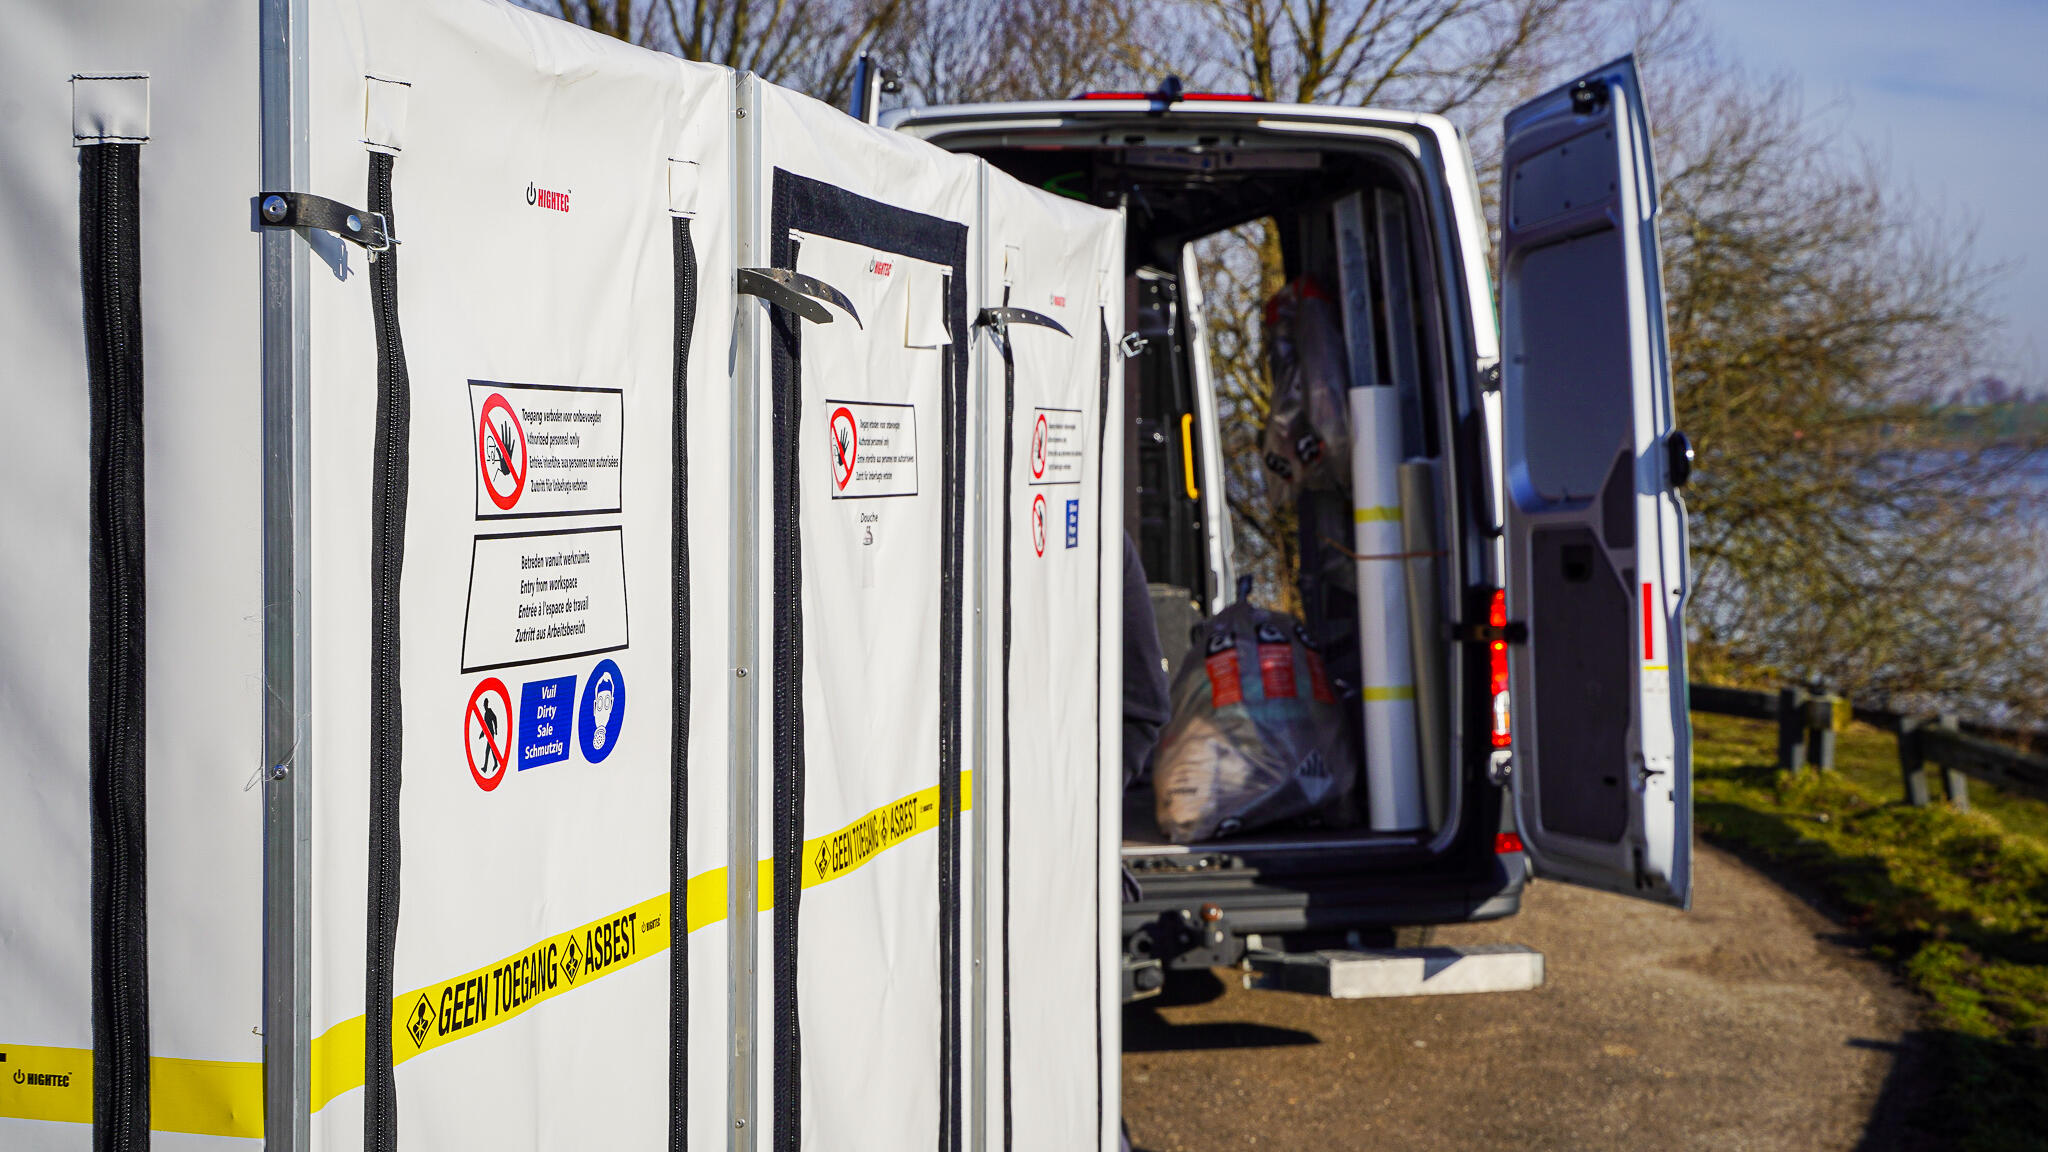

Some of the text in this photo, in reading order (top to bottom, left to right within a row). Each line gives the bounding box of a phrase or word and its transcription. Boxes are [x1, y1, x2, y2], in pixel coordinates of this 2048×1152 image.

[538, 188, 569, 212] HIGHTEC
[522, 408, 543, 425] Toegang
[570, 432, 580, 449] only
[521, 549, 590, 570] Betreden vanuit werkruimte
[520, 575, 577, 597] Entry from workspace
[518, 603, 537, 619] Entrée
[542, 601, 565, 619] l'espace
[566, 598, 573, 613] de
[573, 595, 589, 612] travail
[515, 619, 586, 643] Zutritt aus Arbeitsbereich
[541, 684, 557, 700] Vuil
[536, 704, 557, 720] Dirty
[536, 722, 554, 738] Sale
[524, 739, 564, 760] Schmutzig
[832, 797, 917, 873] GEEN TOEGANG ASBEST
[438, 912, 637, 1037] GEEN TOEGANG ASBEST
[27, 1072, 70, 1088] HIGHTEC
